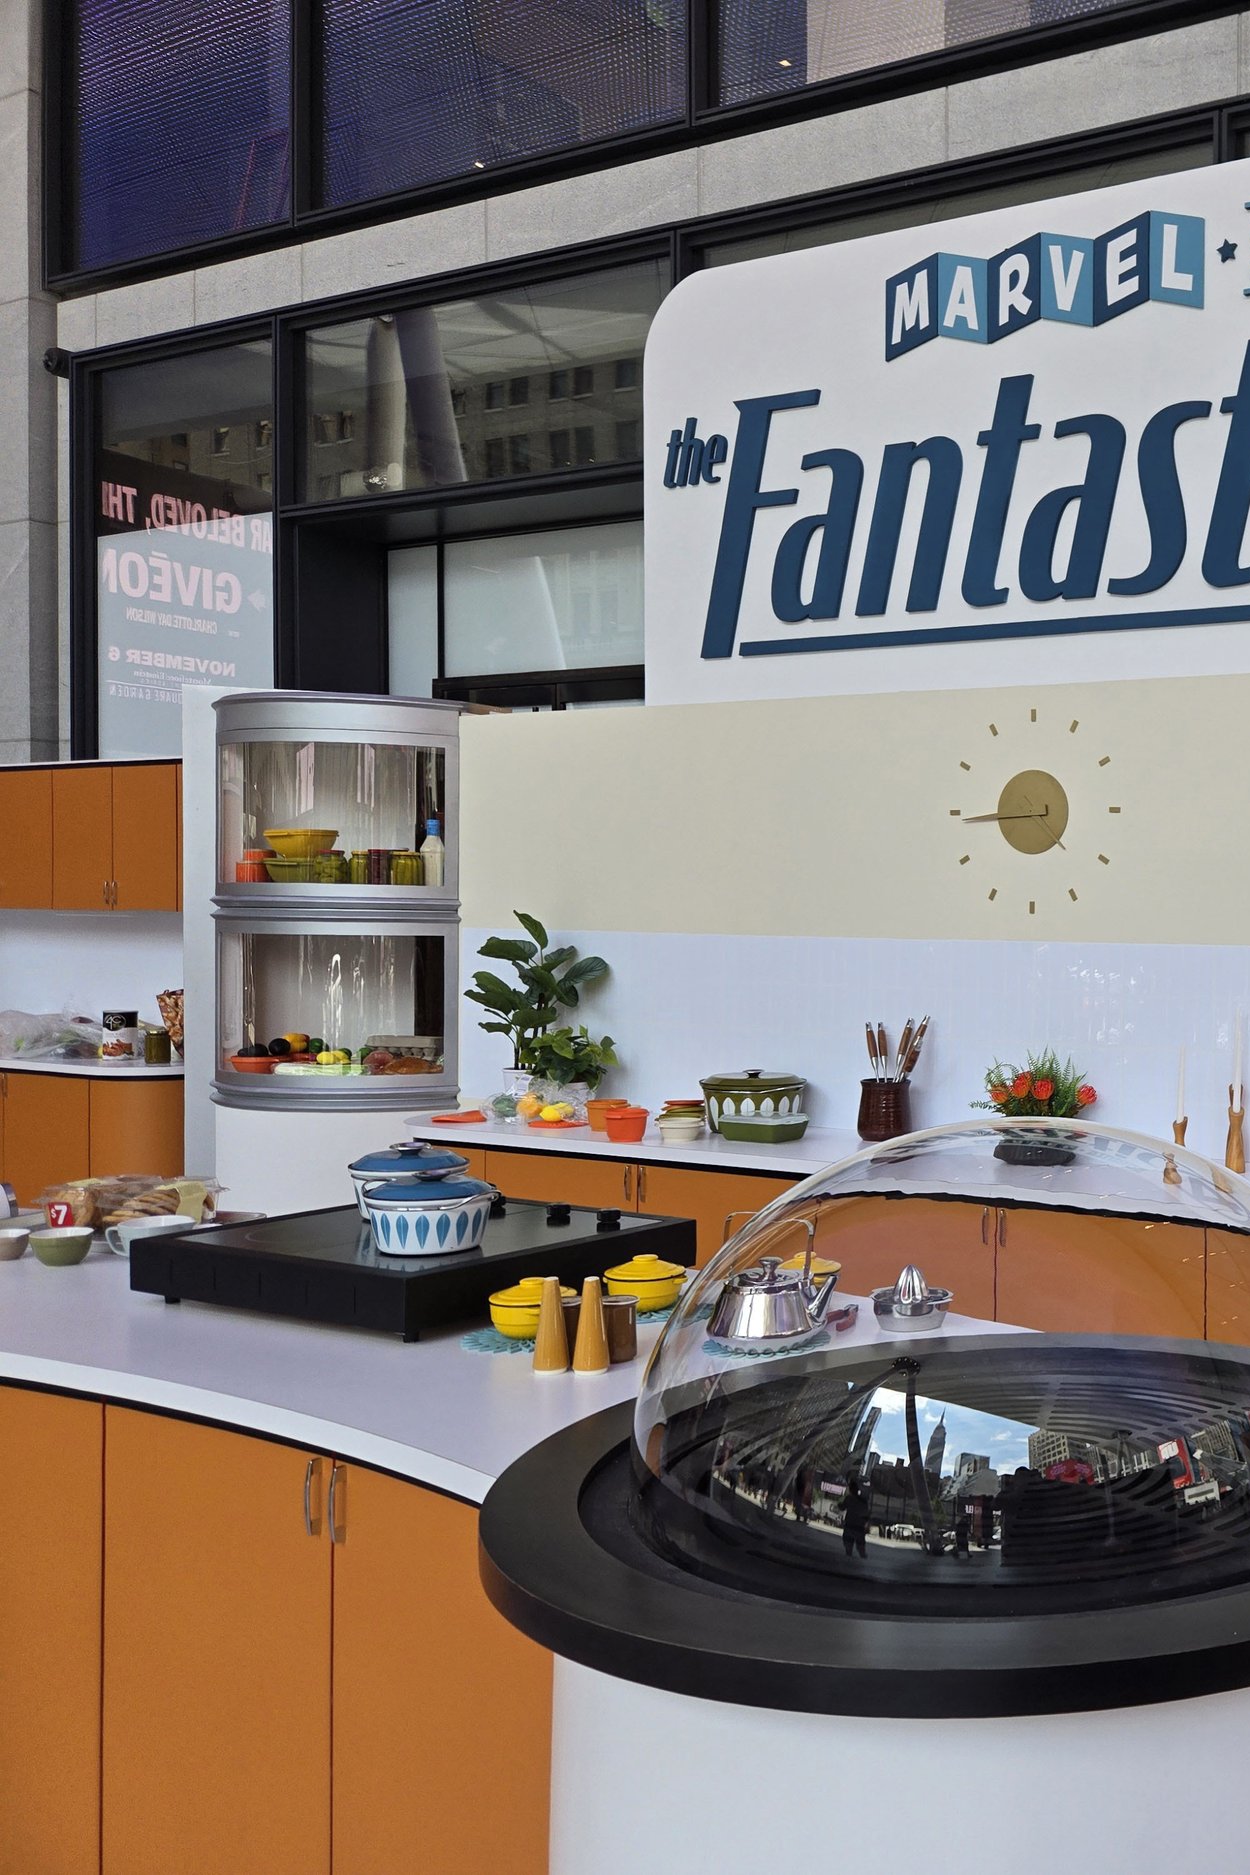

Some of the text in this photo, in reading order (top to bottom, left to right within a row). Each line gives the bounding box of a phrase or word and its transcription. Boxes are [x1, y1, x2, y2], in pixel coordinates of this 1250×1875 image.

[889, 222, 1196, 347] MARVEL
[663, 417, 728, 489] the
[50, 1204, 68, 1226] $7
